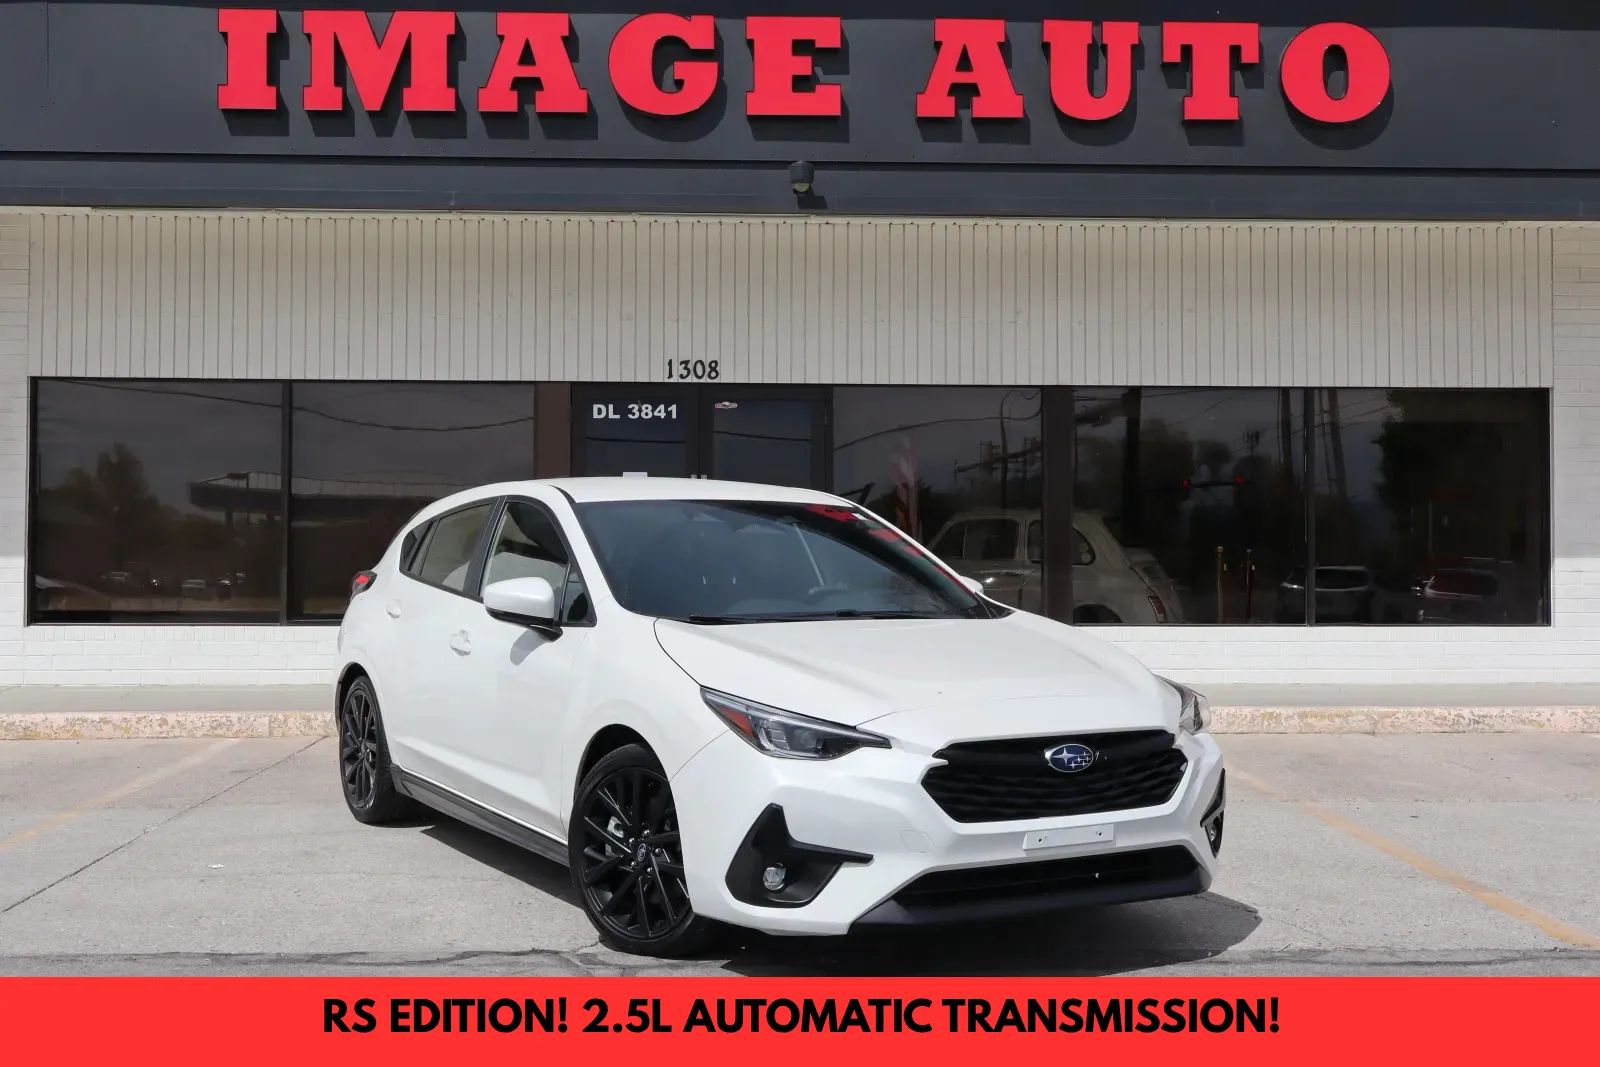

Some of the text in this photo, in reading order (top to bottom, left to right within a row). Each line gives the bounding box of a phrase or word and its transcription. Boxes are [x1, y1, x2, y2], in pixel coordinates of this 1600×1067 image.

[217, 8, 1392, 123] IMAGE AUTO
[666, 358, 720, 380] 1308
[592, 403, 678, 420] DL 3841
